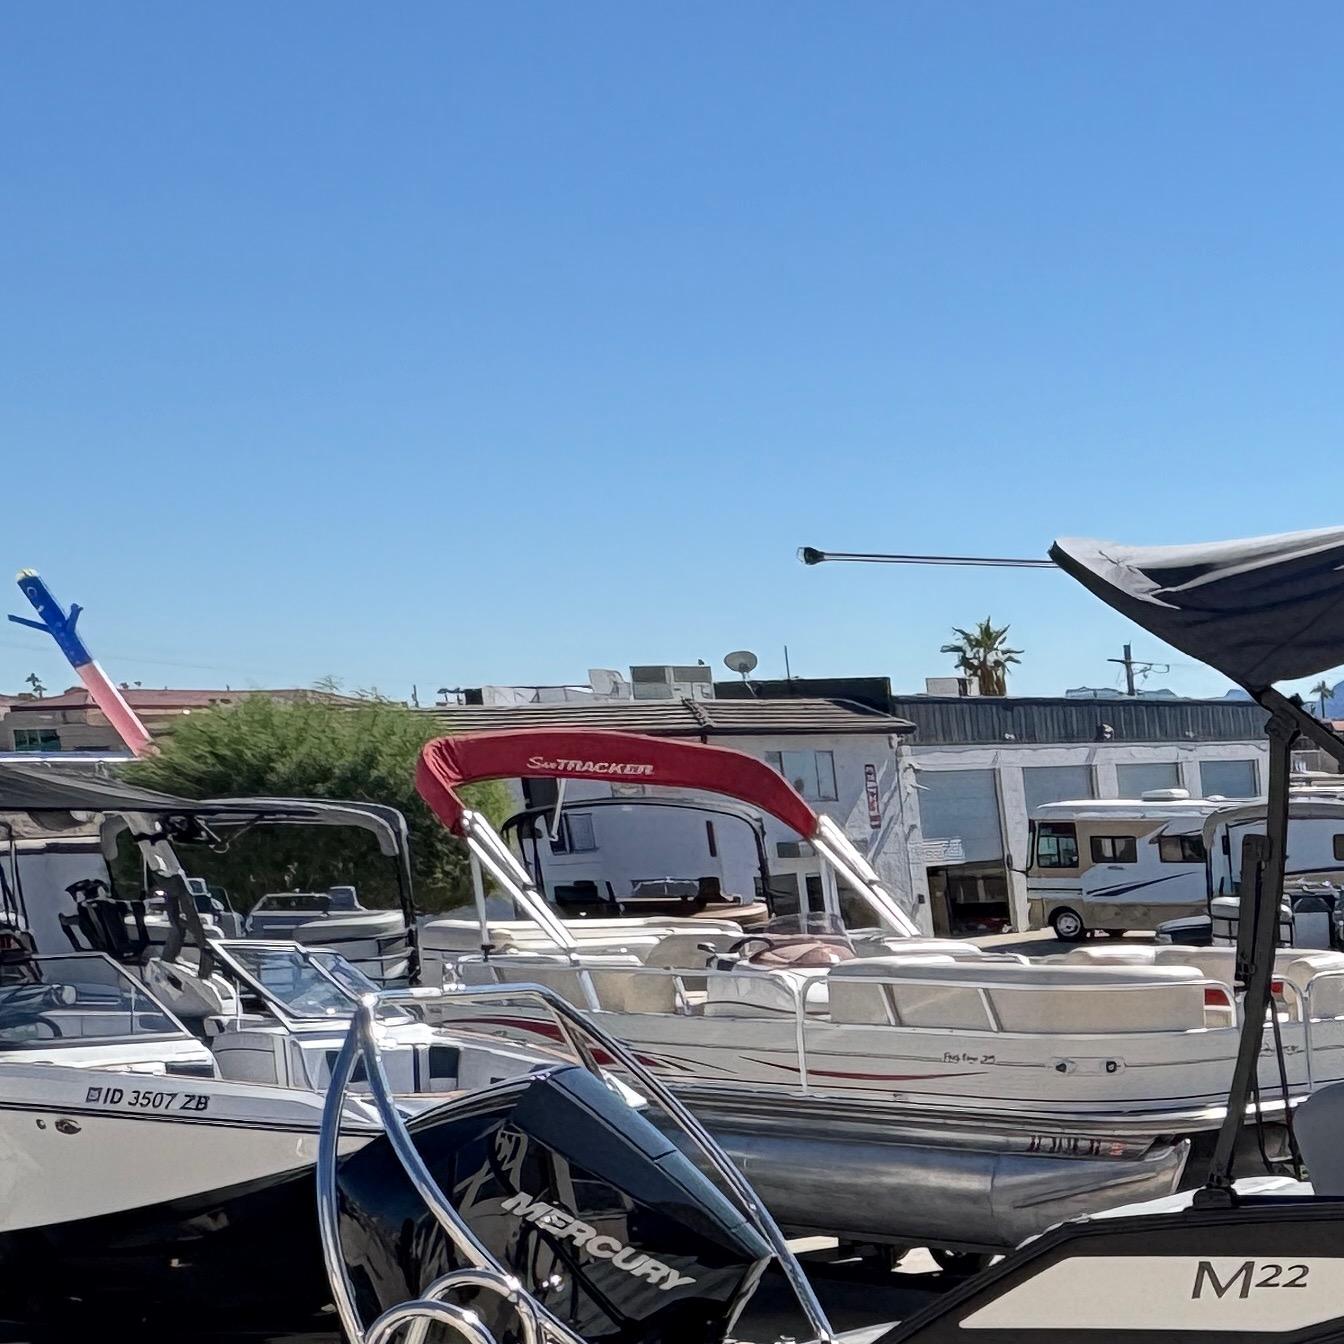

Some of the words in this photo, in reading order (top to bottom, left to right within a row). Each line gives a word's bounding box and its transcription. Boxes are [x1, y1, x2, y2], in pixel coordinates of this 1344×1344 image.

[103, 1087, 124, 1105] ID
[128, 1090, 178, 1110] 3507
[500, 1191, 697, 1291] MERCURY
